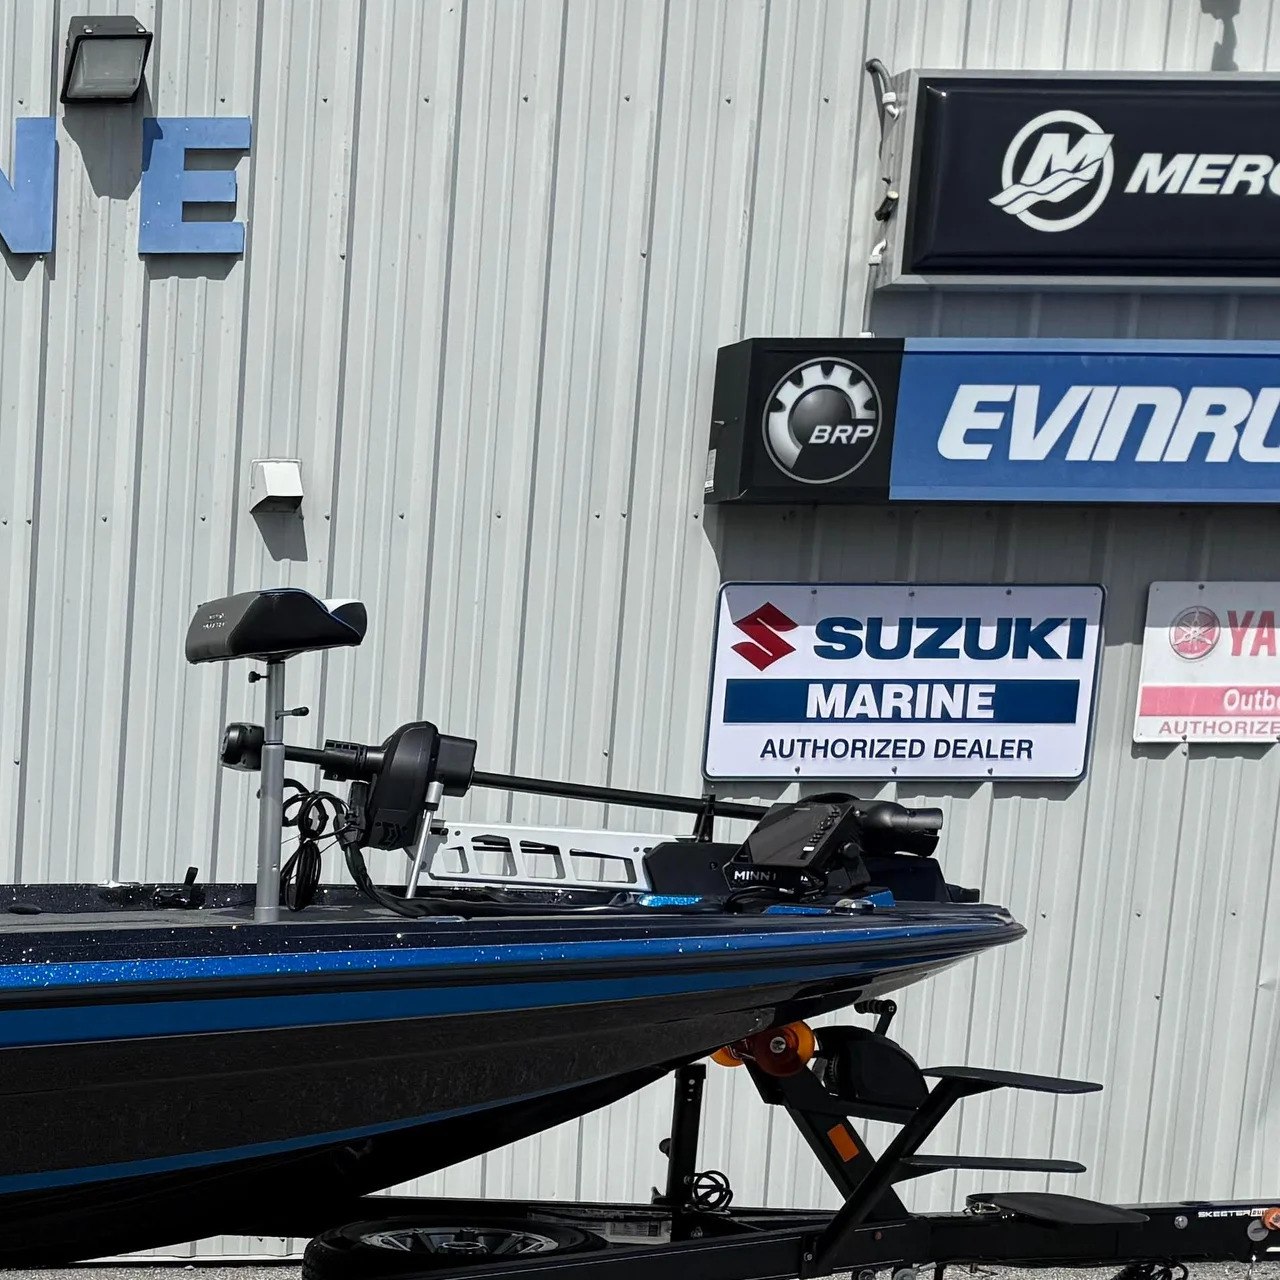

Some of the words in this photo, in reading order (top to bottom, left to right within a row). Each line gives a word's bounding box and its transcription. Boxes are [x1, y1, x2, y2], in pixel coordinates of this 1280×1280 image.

[1123, 152, 1280, 196] MER
[808, 425, 874, 444] BRP
[813, 616, 1088, 660] SUZUKI
[1227, 610, 1277, 657] YA
[806, 683, 997, 719] MARINE
[1223, 688, 1280, 711] Outb
[760, 738, 926, 759] AUTHORIZED
[933, 738, 1035, 759] DEALER
